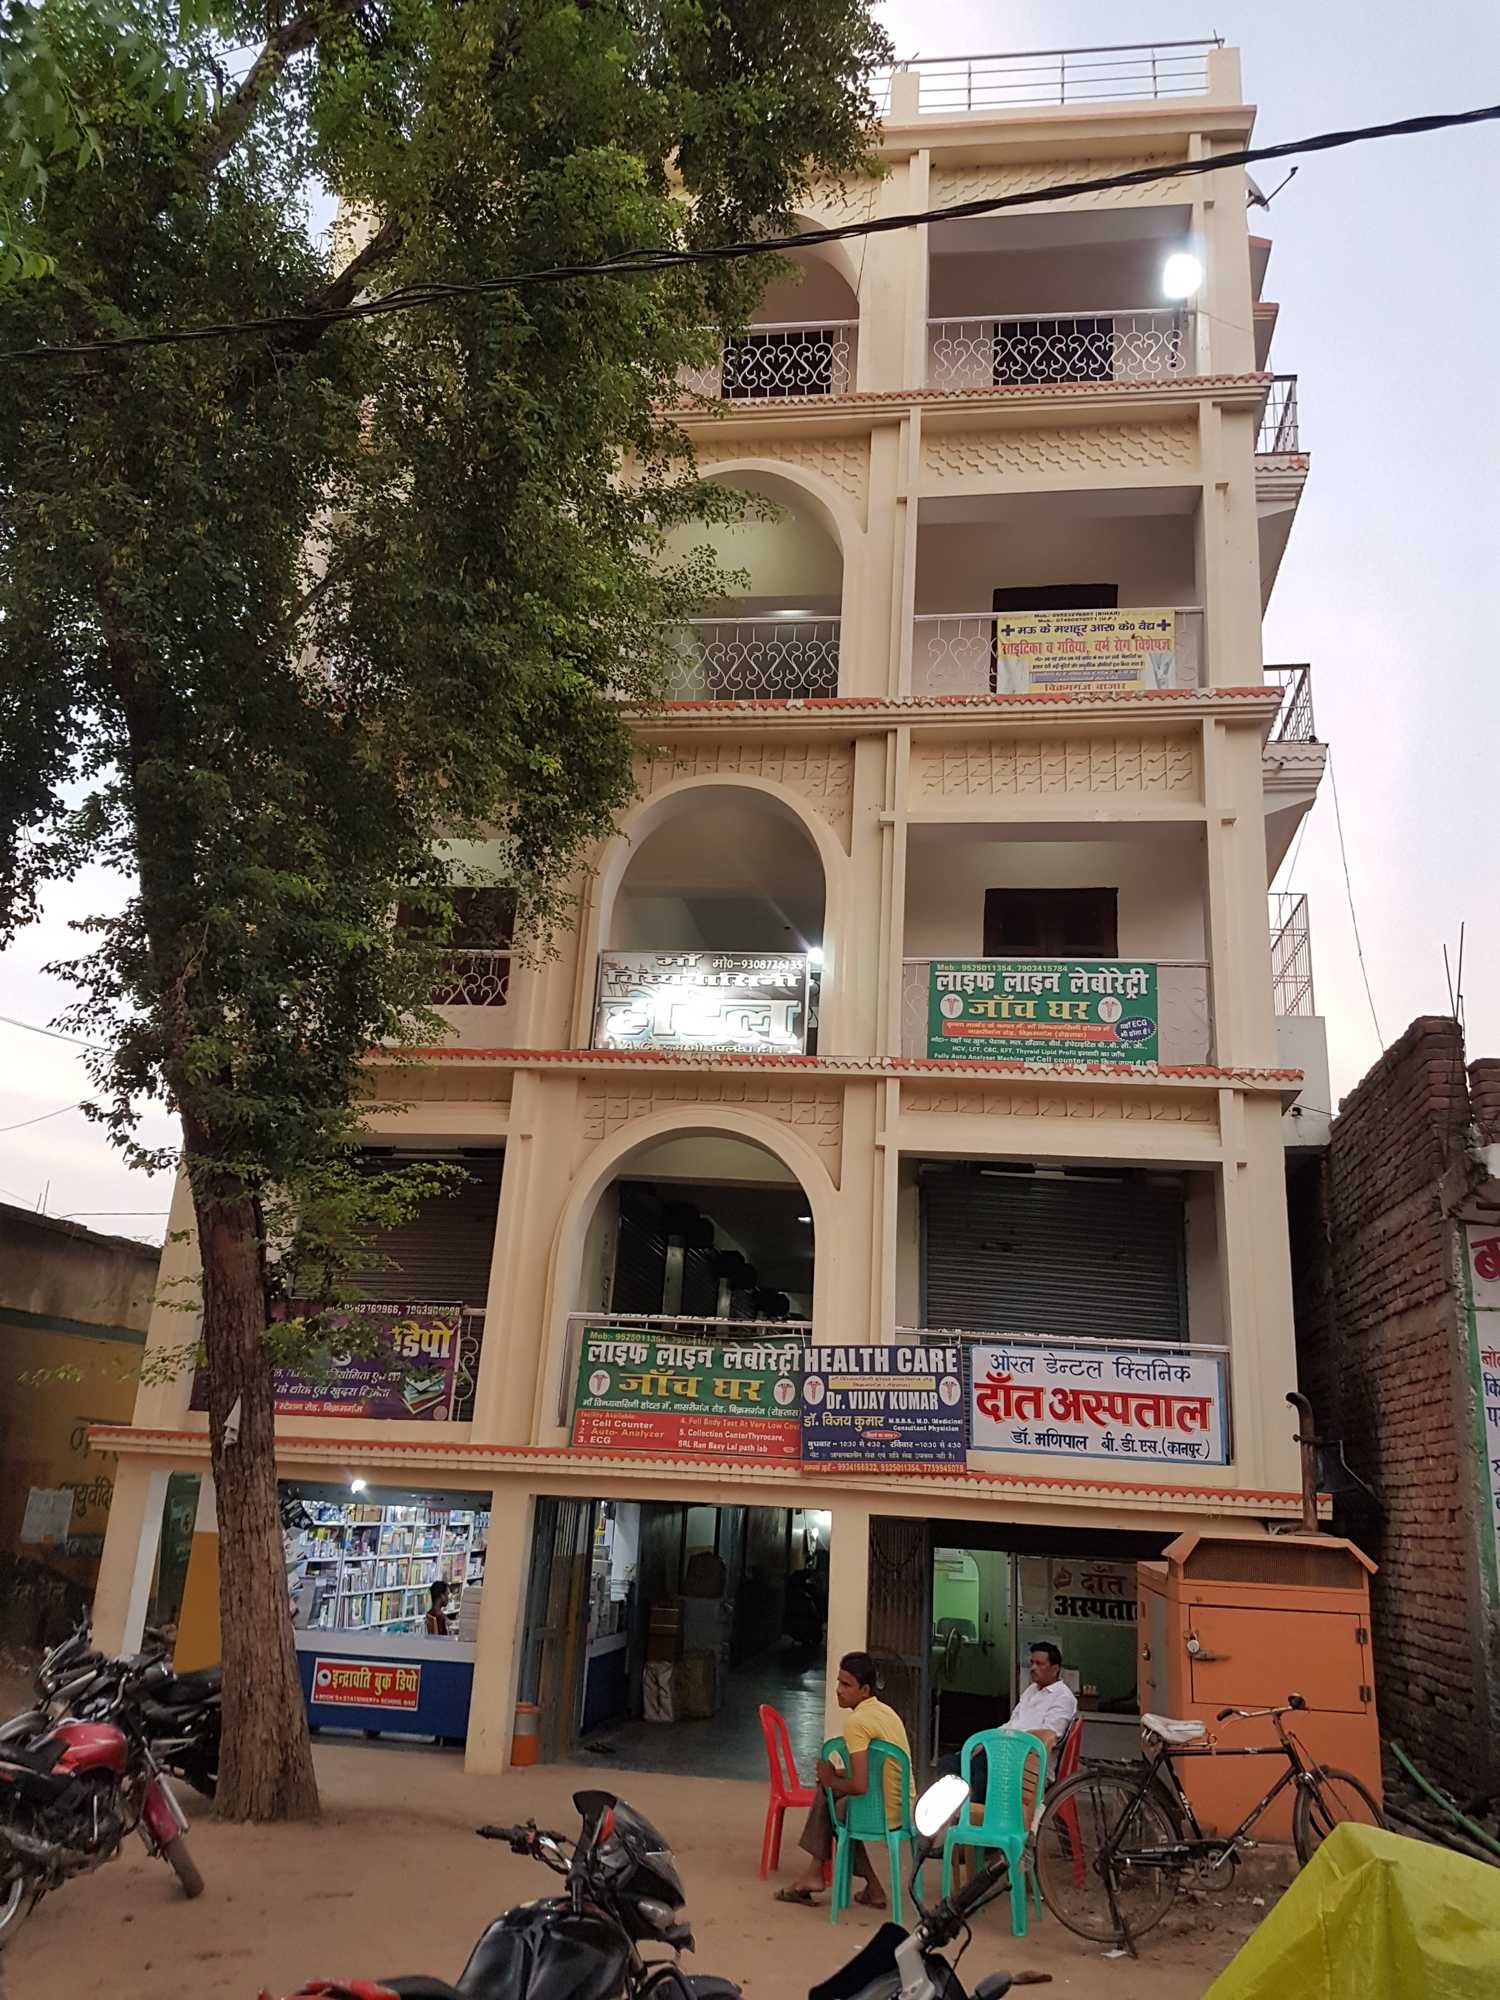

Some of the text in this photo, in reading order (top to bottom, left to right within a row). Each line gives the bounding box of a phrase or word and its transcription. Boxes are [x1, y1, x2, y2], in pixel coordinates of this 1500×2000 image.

[1040, 624, 1051, 634] के
[936, 967, 1149, 999] लाइफ लाइन लेबोरेट्री
[968, 994, 1091, 1020] जाँच घर
[1132, 1020, 1147, 1028] ECG
[588, 1341, 801, 1376] लाइफ लाइन लेबोरेट्री
[804, 1347, 958, 1373] HEALTH CARE
[990, 1350, 1191, 1383] ओरल डेन्टल क्लिनिक
[619, 1368, 764, 1401] जाँच घर
[826, 1391, 939, 1410] Dr. VIJAY KUMAR
[975, 1371, 1214, 1434] दाँत अस्पताल
[592, 1419, 611, 1427] Cell
[614, 1420, 654, 1428] Counter
[688, 1429, 723, 1438] Collection
[822, 1411, 851, 1427] विजय
[854, 1415, 885, 1432] कुमार
[590, 1436, 611, 1444] ECG
[1035, 1429, 1089, 1451] मणिपाल
[1080, 1565, 1127, 1596] दाँत
[1055, 1595, 1137, 1622] अस्पता
[375, 1672, 393, 1696] बुक
[396, 1669, 417, 1692] डिपो
